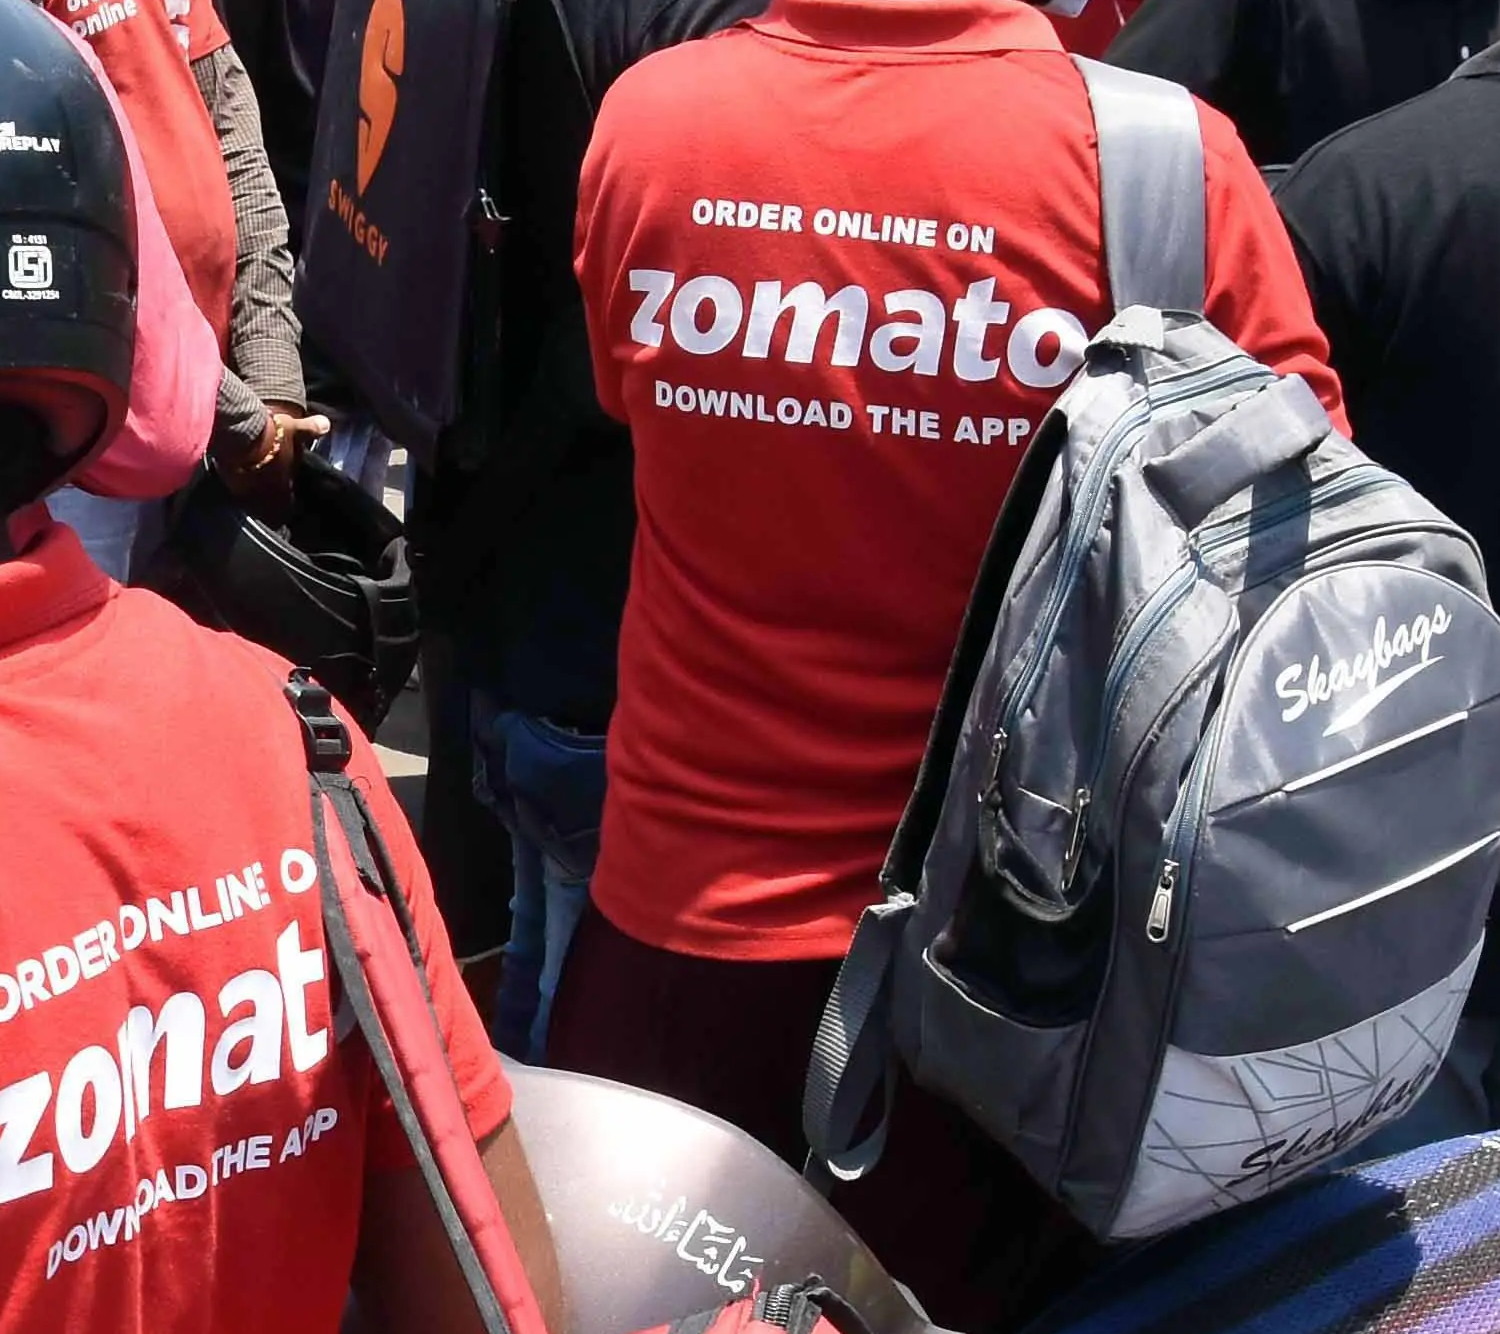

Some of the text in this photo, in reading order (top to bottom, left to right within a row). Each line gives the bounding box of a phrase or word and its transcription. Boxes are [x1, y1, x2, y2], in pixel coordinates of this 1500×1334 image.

[327, 178, 390, 267] SWIGGY
[691, 197, 996, 255] ORDER ONLINE ON
[627, 267, 1090, 392] zomato
[654, 379, 1032, 448] DOWNLOAD THE APP
[1275, 603, 1453, 722] Skaybags
[119, 861, 265, 950] ONLINE
[277, 847, 317, 894] O
[45, 1106, 339, 1279] DOWNOAD THE APP
